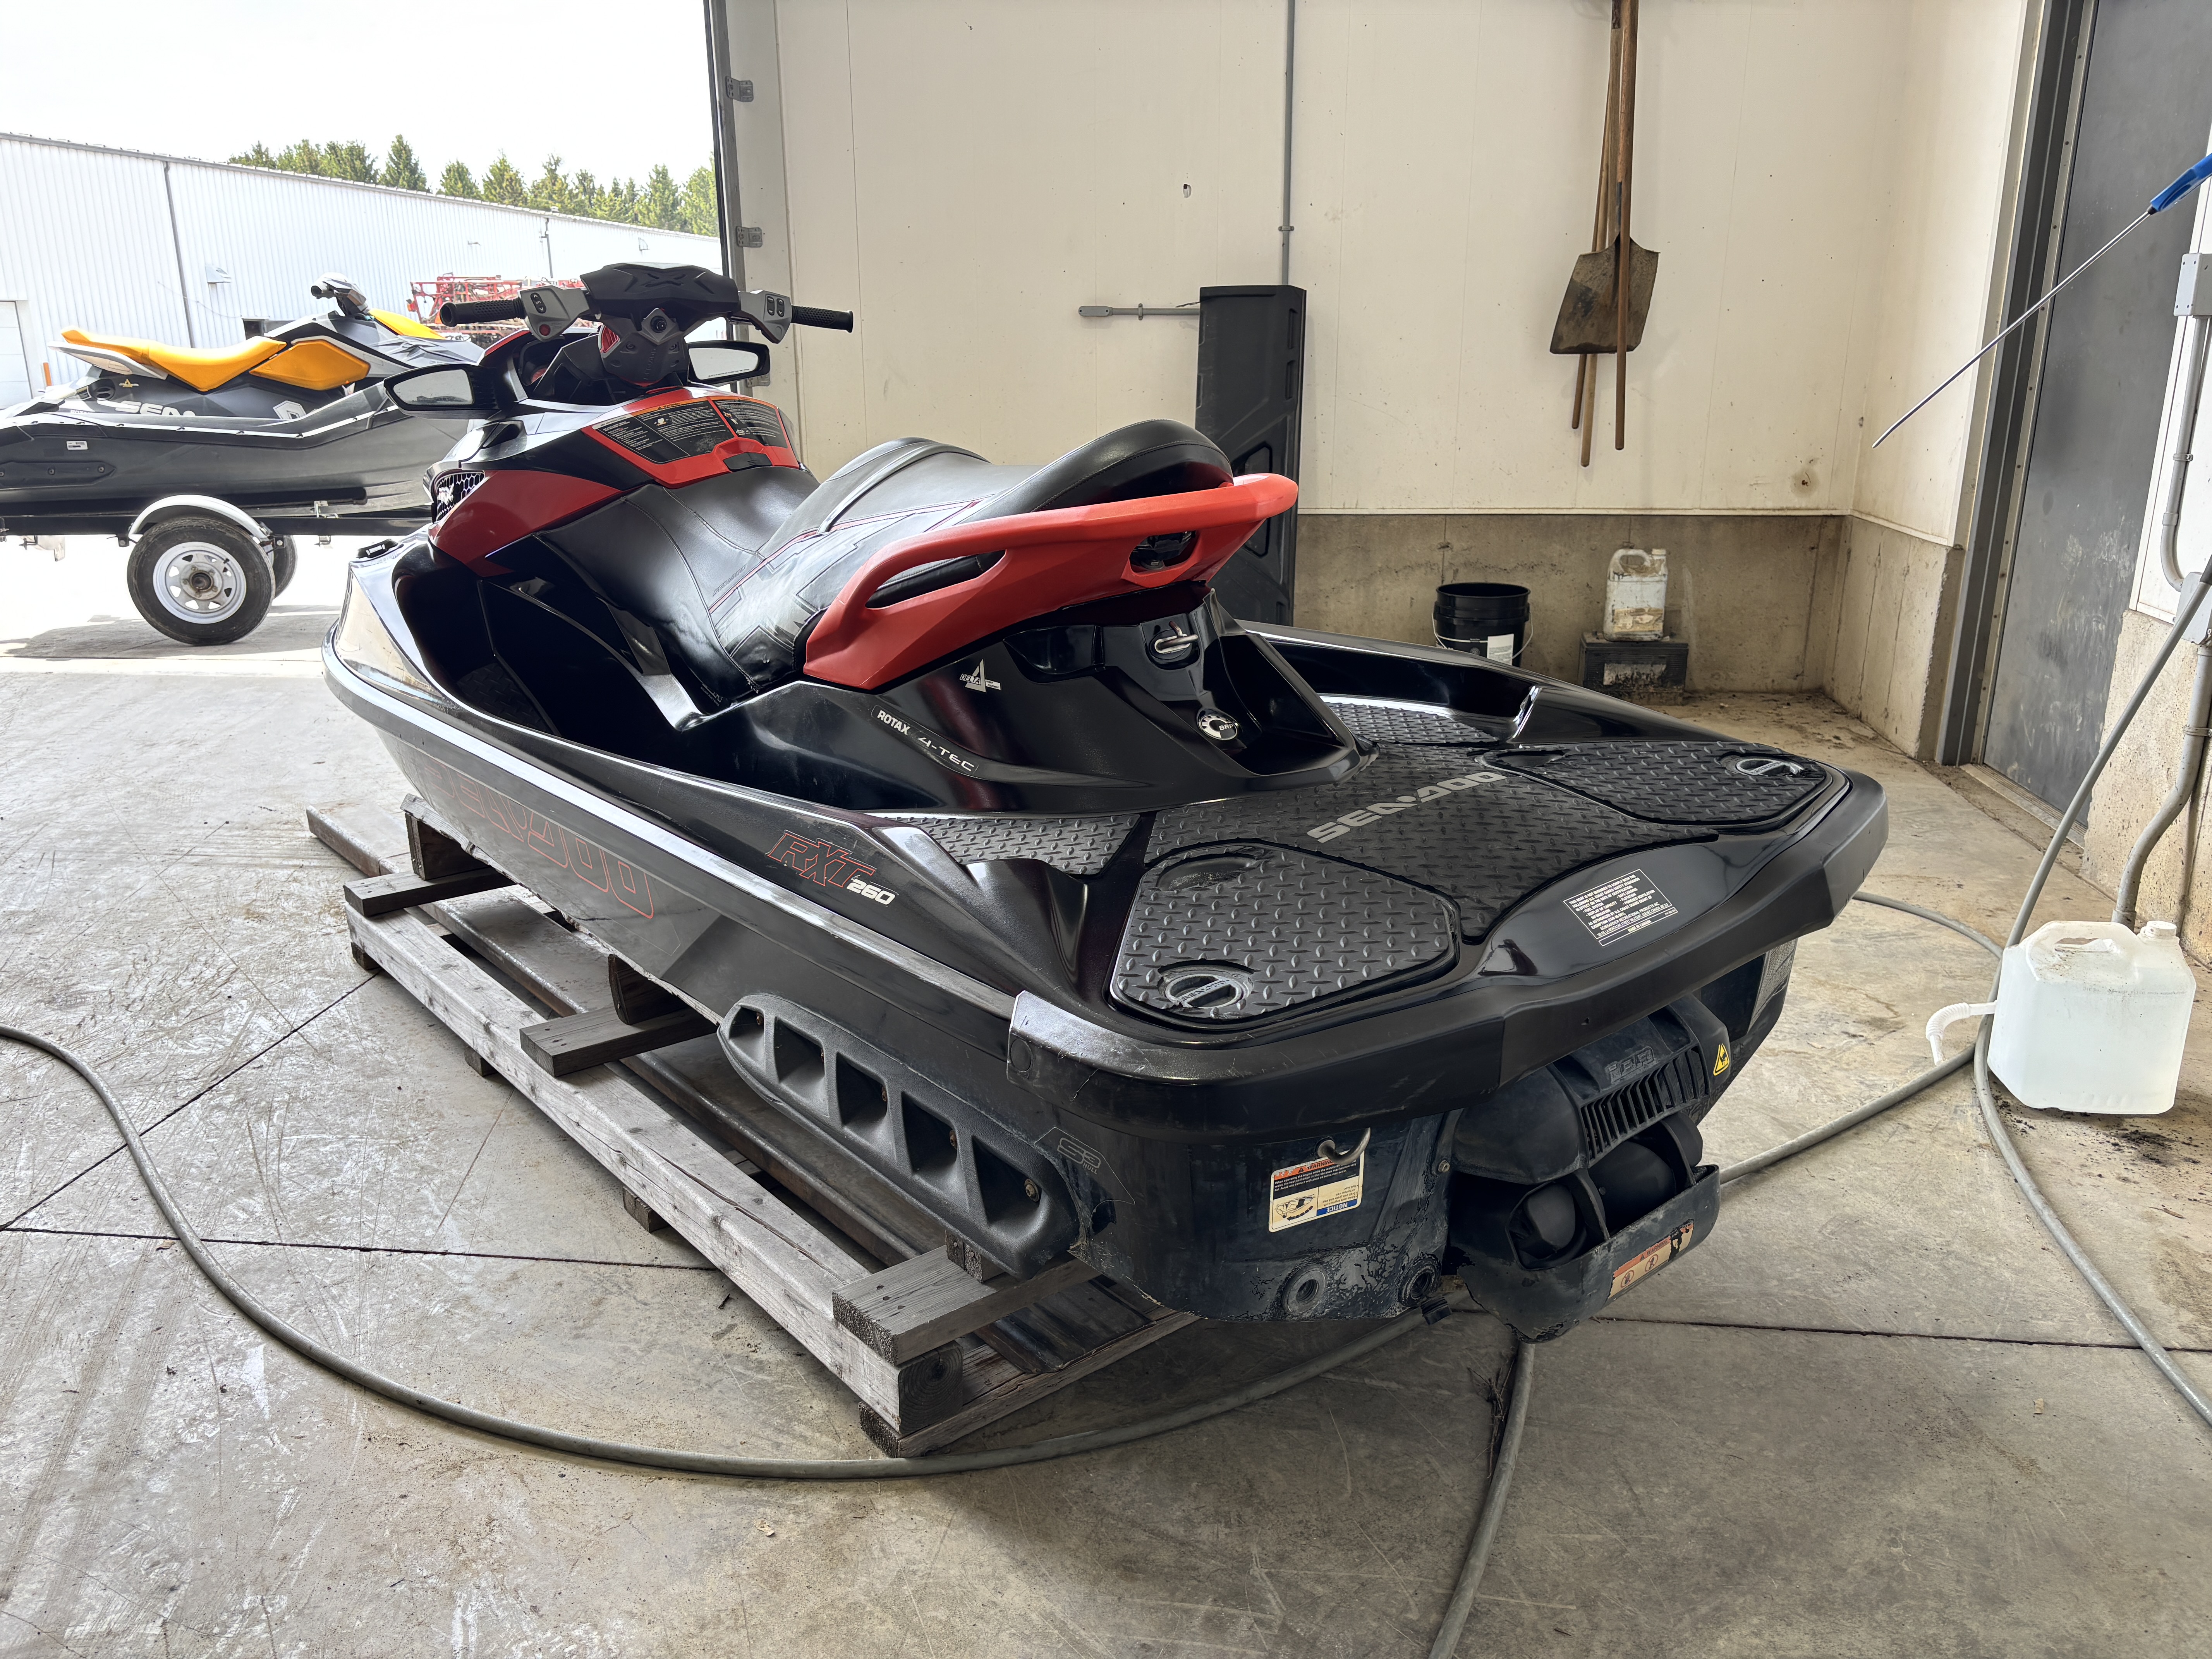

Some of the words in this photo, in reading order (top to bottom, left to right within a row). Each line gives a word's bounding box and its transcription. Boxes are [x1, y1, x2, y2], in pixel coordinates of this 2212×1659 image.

[960, 674, 980, 684] DELTA
[877, 710, 910, 735] ROTAX
[917, 737, 974, 772] 4-TEC
[768, 833, 876, 888] RXT
[847, 878, 895, 905] 260
[1056, 1137, 1101, 1169] S3
[1083, 1162, 1097, 1175] HULL
[1326, 1202, 1348, 1213] NOTICE
